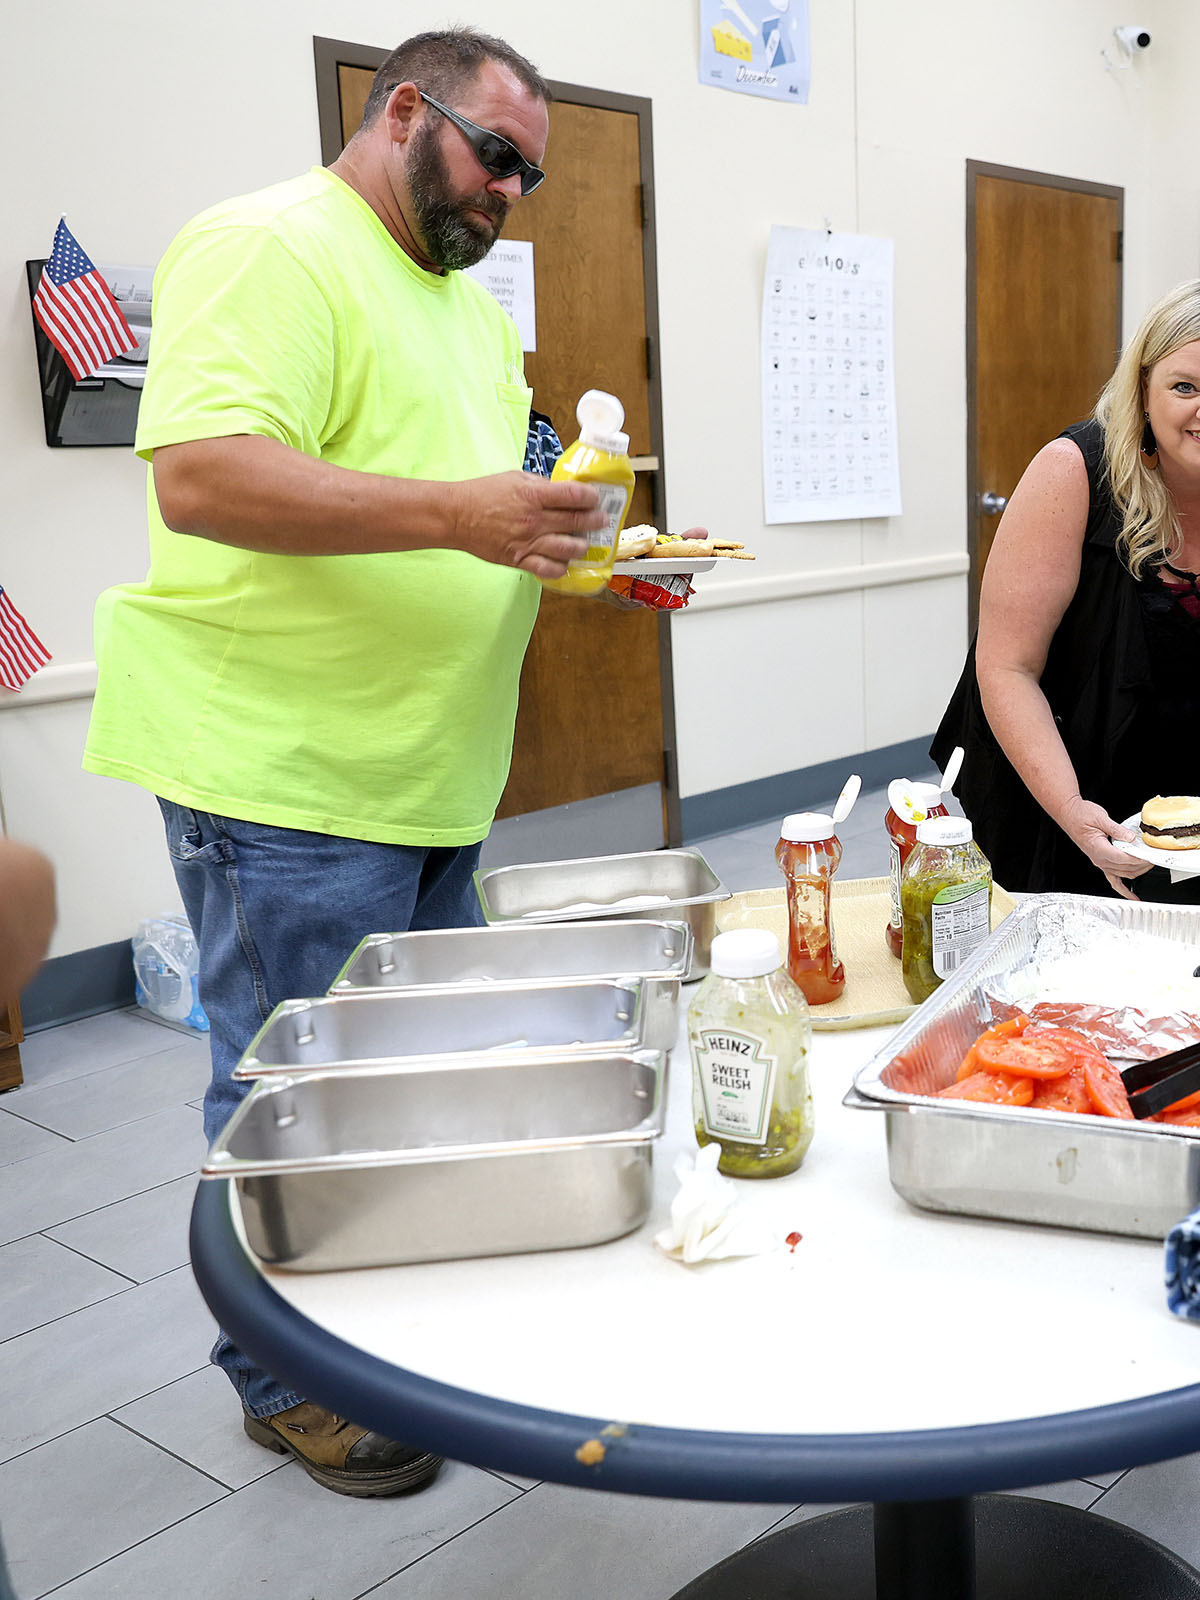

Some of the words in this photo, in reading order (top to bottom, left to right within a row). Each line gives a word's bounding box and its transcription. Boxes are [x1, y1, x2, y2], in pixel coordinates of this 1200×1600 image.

[708, 1037, 751, 1056] HEINZ
[711, 1062, 750, 1080] SWEET
[712, 1074, 752, 1091] RELISH
